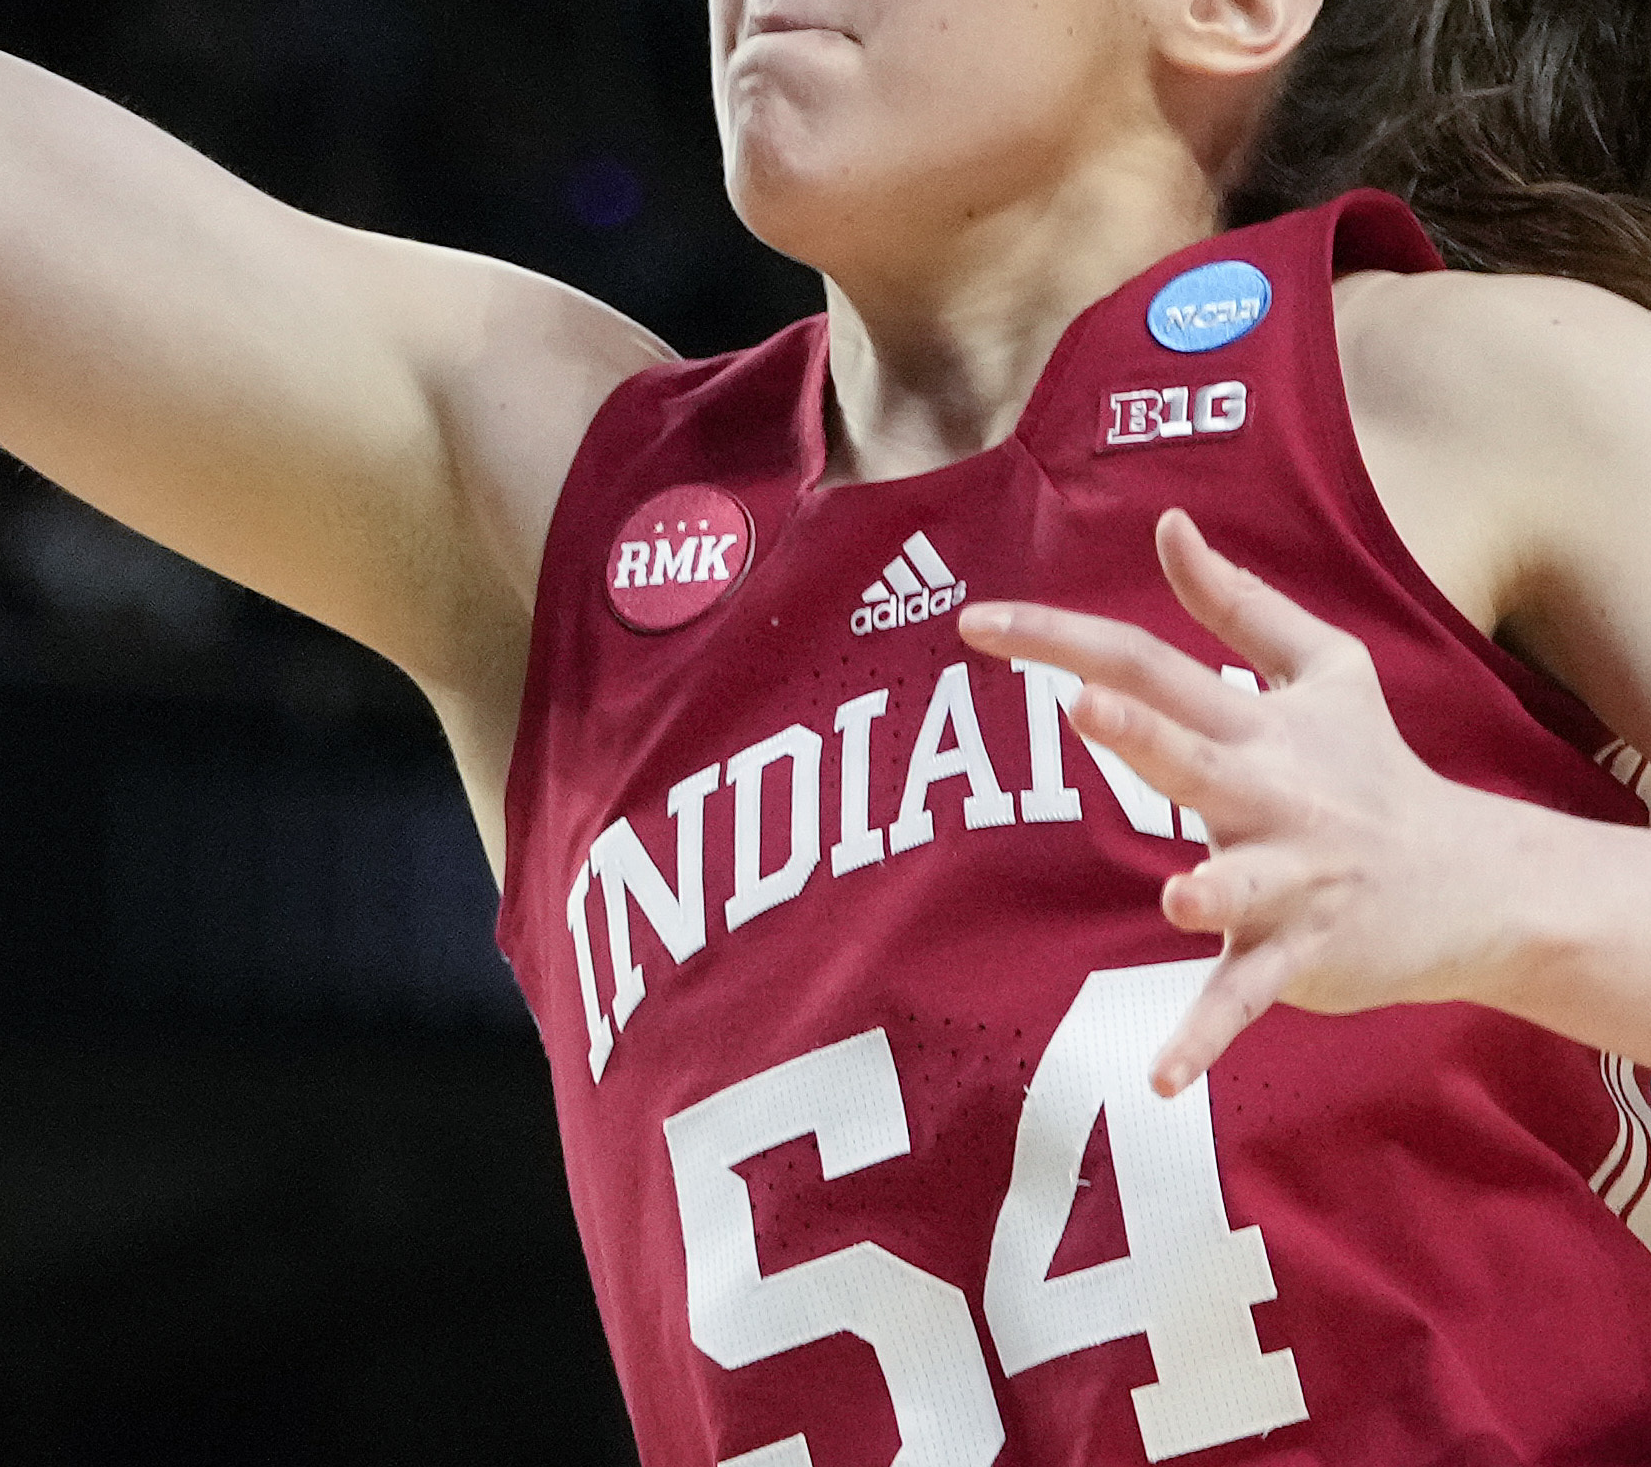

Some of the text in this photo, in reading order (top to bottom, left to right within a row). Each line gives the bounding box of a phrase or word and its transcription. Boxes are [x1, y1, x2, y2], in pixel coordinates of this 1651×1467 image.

[1165, 297, 1260, 332] NCAA
[613, 533, 738, 589] RMK
[850, 580, 967, 636] adidas
[566, 657, 1260, 1084] INDIAN
